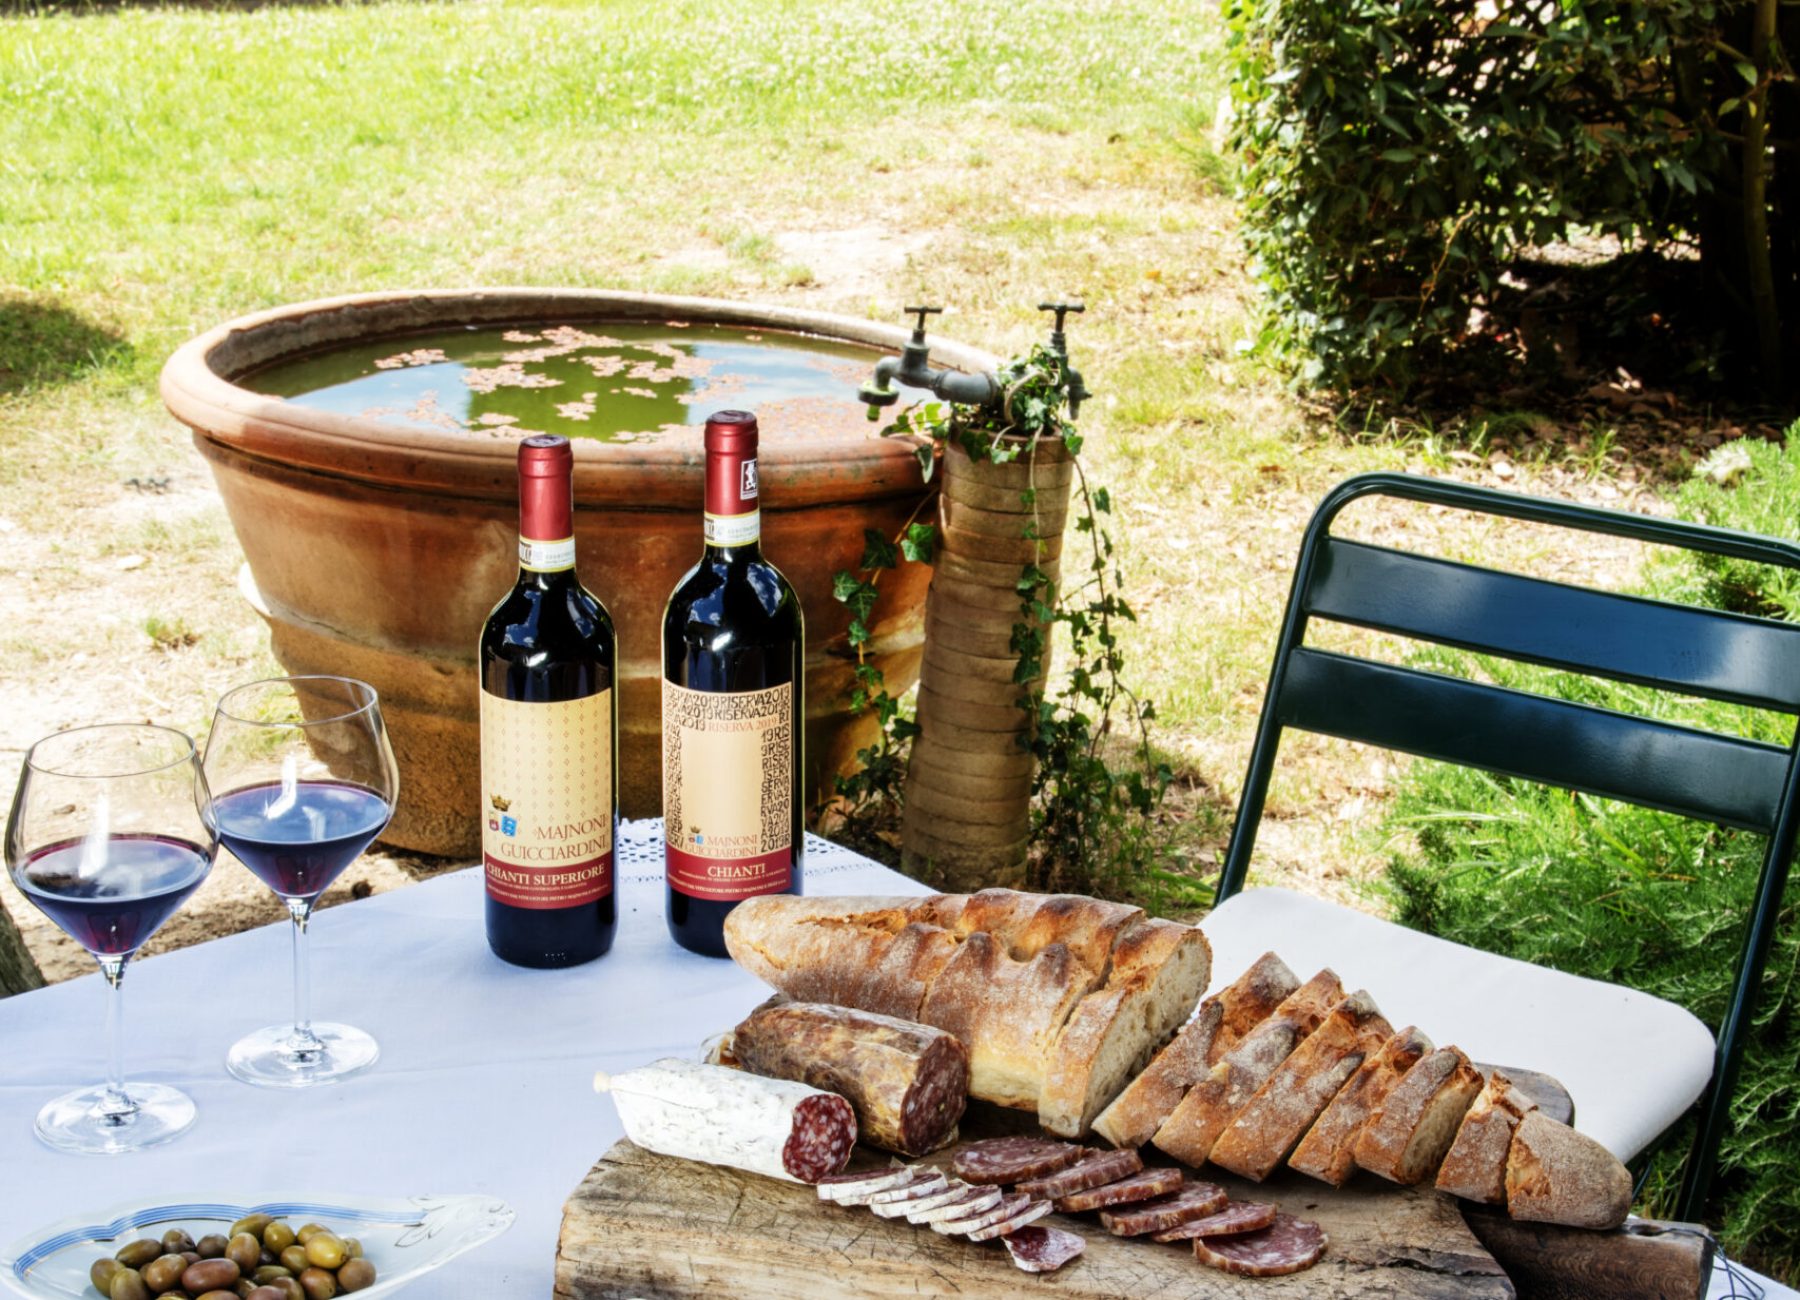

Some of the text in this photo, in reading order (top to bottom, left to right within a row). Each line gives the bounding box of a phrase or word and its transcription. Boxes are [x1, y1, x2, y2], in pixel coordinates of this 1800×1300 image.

[707, 717, 778, 734] RISERVA 2019
[537, 813, 606, 841] MAJNONI
[501, 834, 606, 861] GUICCIARDINI
[707, 834, 758, 847] MAJNONI
[685, 846, 758, 858] GUICCIARDINI
[486, 862, 529, 885] CHIANTI
[533, 863, 605, 886] SUPERIORE
[707, 863, 766, 878] CHIANTI
